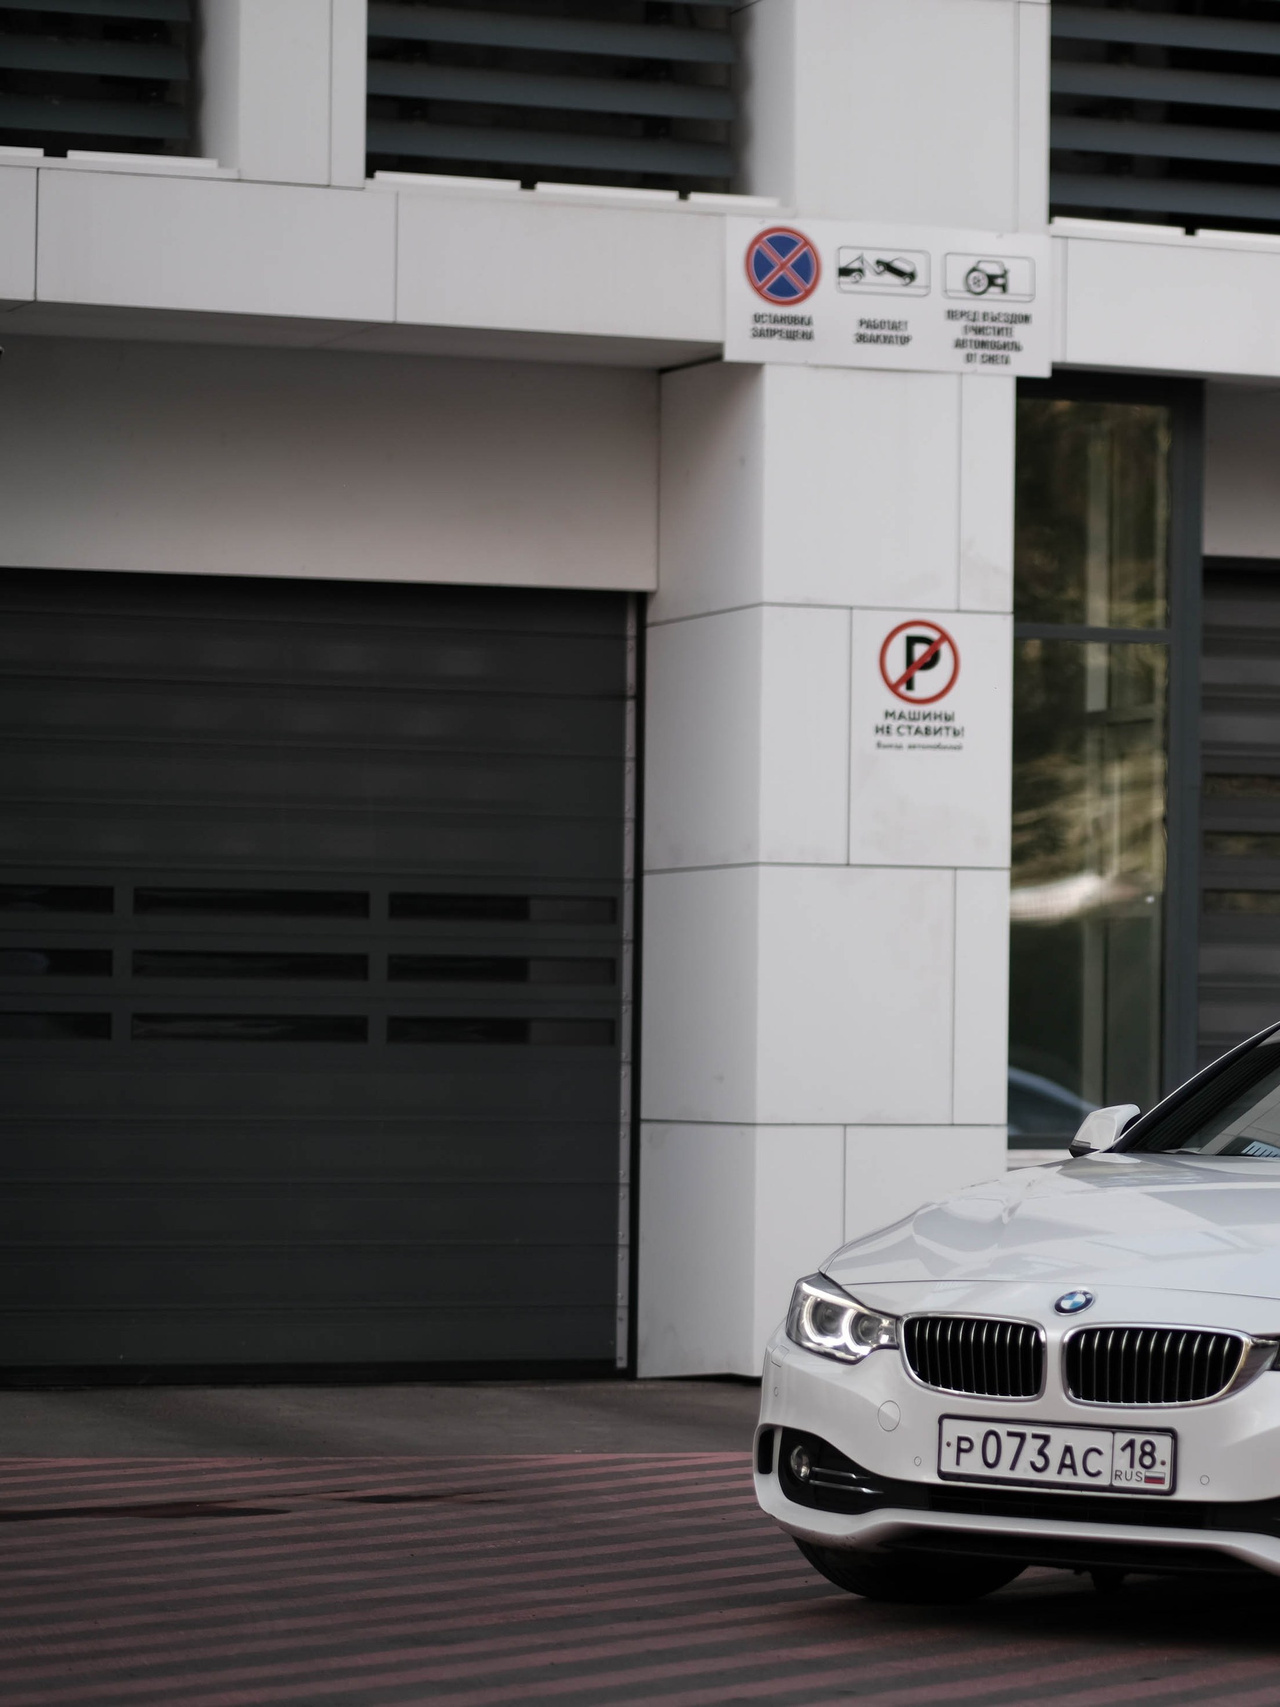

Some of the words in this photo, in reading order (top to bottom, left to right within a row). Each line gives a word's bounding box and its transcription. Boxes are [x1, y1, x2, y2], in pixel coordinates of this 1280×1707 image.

[753, 313, 813, 327] ОСТАНОВКА
[946, 309, 980, 322] ПЕРЕД
[858, 318, 909, 331] РАБОТАЕТ
[751, 327, 814, 341] ЗАПРЕЩЕНА
[854, 332, 912, 345] ЭВАКУАТОР
[954, 338, 1023, 352] АВТОМОБИЛЬ
[884, 709, 956, 722] МАШИНЫ
[875, 724, 893, 736] НЕ
[896, 724, 964, 738] СТАВИТЬ!
[1120, 1437, 1157, 1470] 18
[1114, 1469, 1143, 1483] RUS
